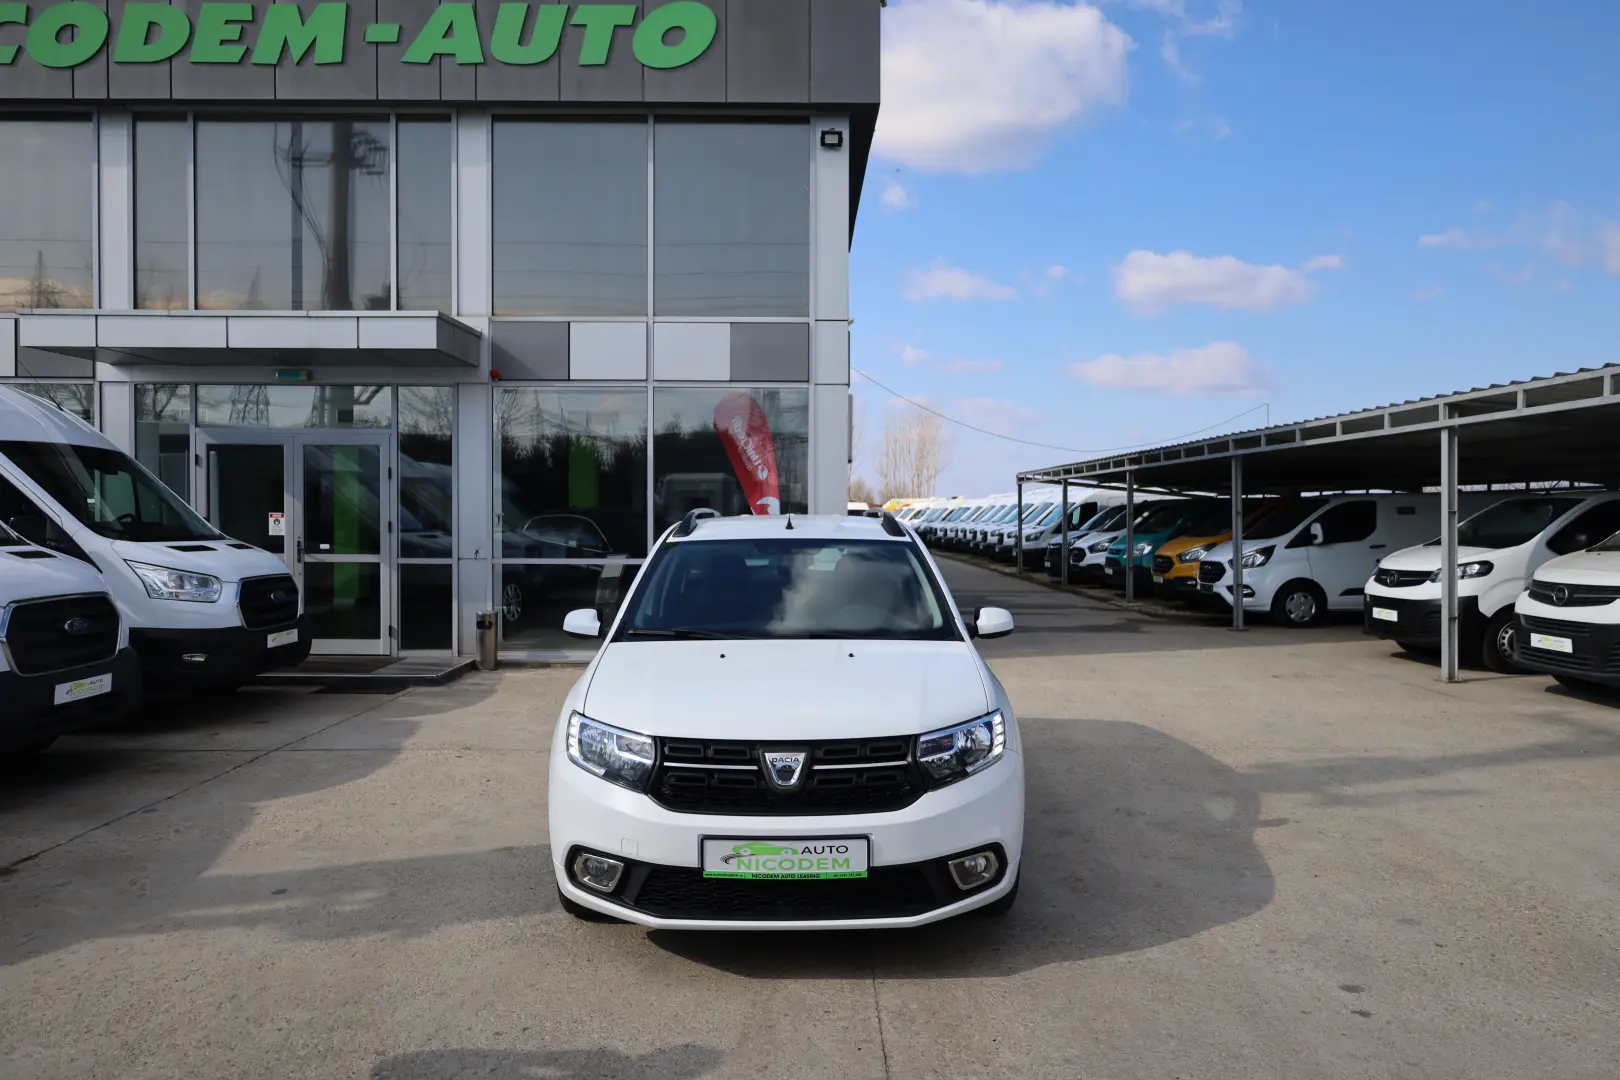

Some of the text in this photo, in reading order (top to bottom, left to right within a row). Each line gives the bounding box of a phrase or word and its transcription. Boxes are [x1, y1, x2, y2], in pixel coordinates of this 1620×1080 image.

[90, 678, 104, 686] AUTO
[801, 845, 849, 855] AUTO
[736, 856, 850, 871] NICODEM
